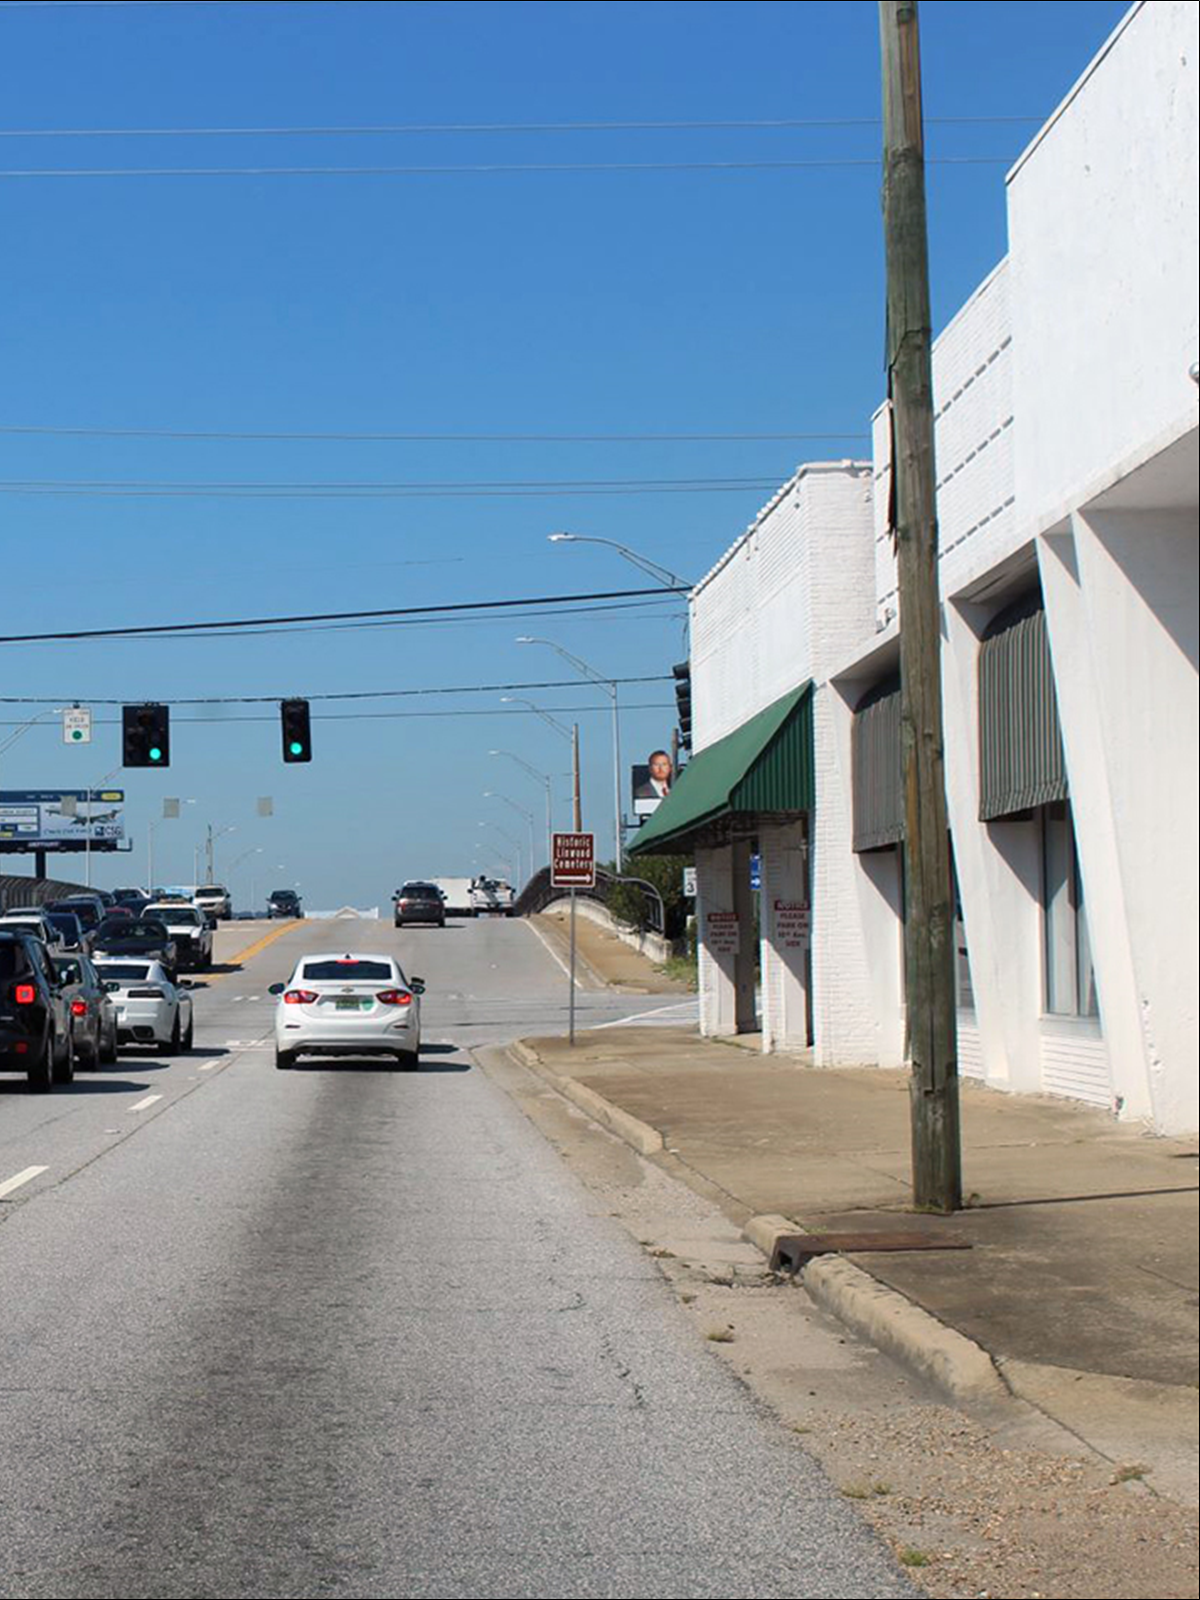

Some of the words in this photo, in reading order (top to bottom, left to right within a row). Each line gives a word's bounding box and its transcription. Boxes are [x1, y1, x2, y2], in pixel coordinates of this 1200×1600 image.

[557, 836, 591, 847] Historic
[557, 847, 590, 858] Linwood
[555, 858, 593, 871] Cemetery
